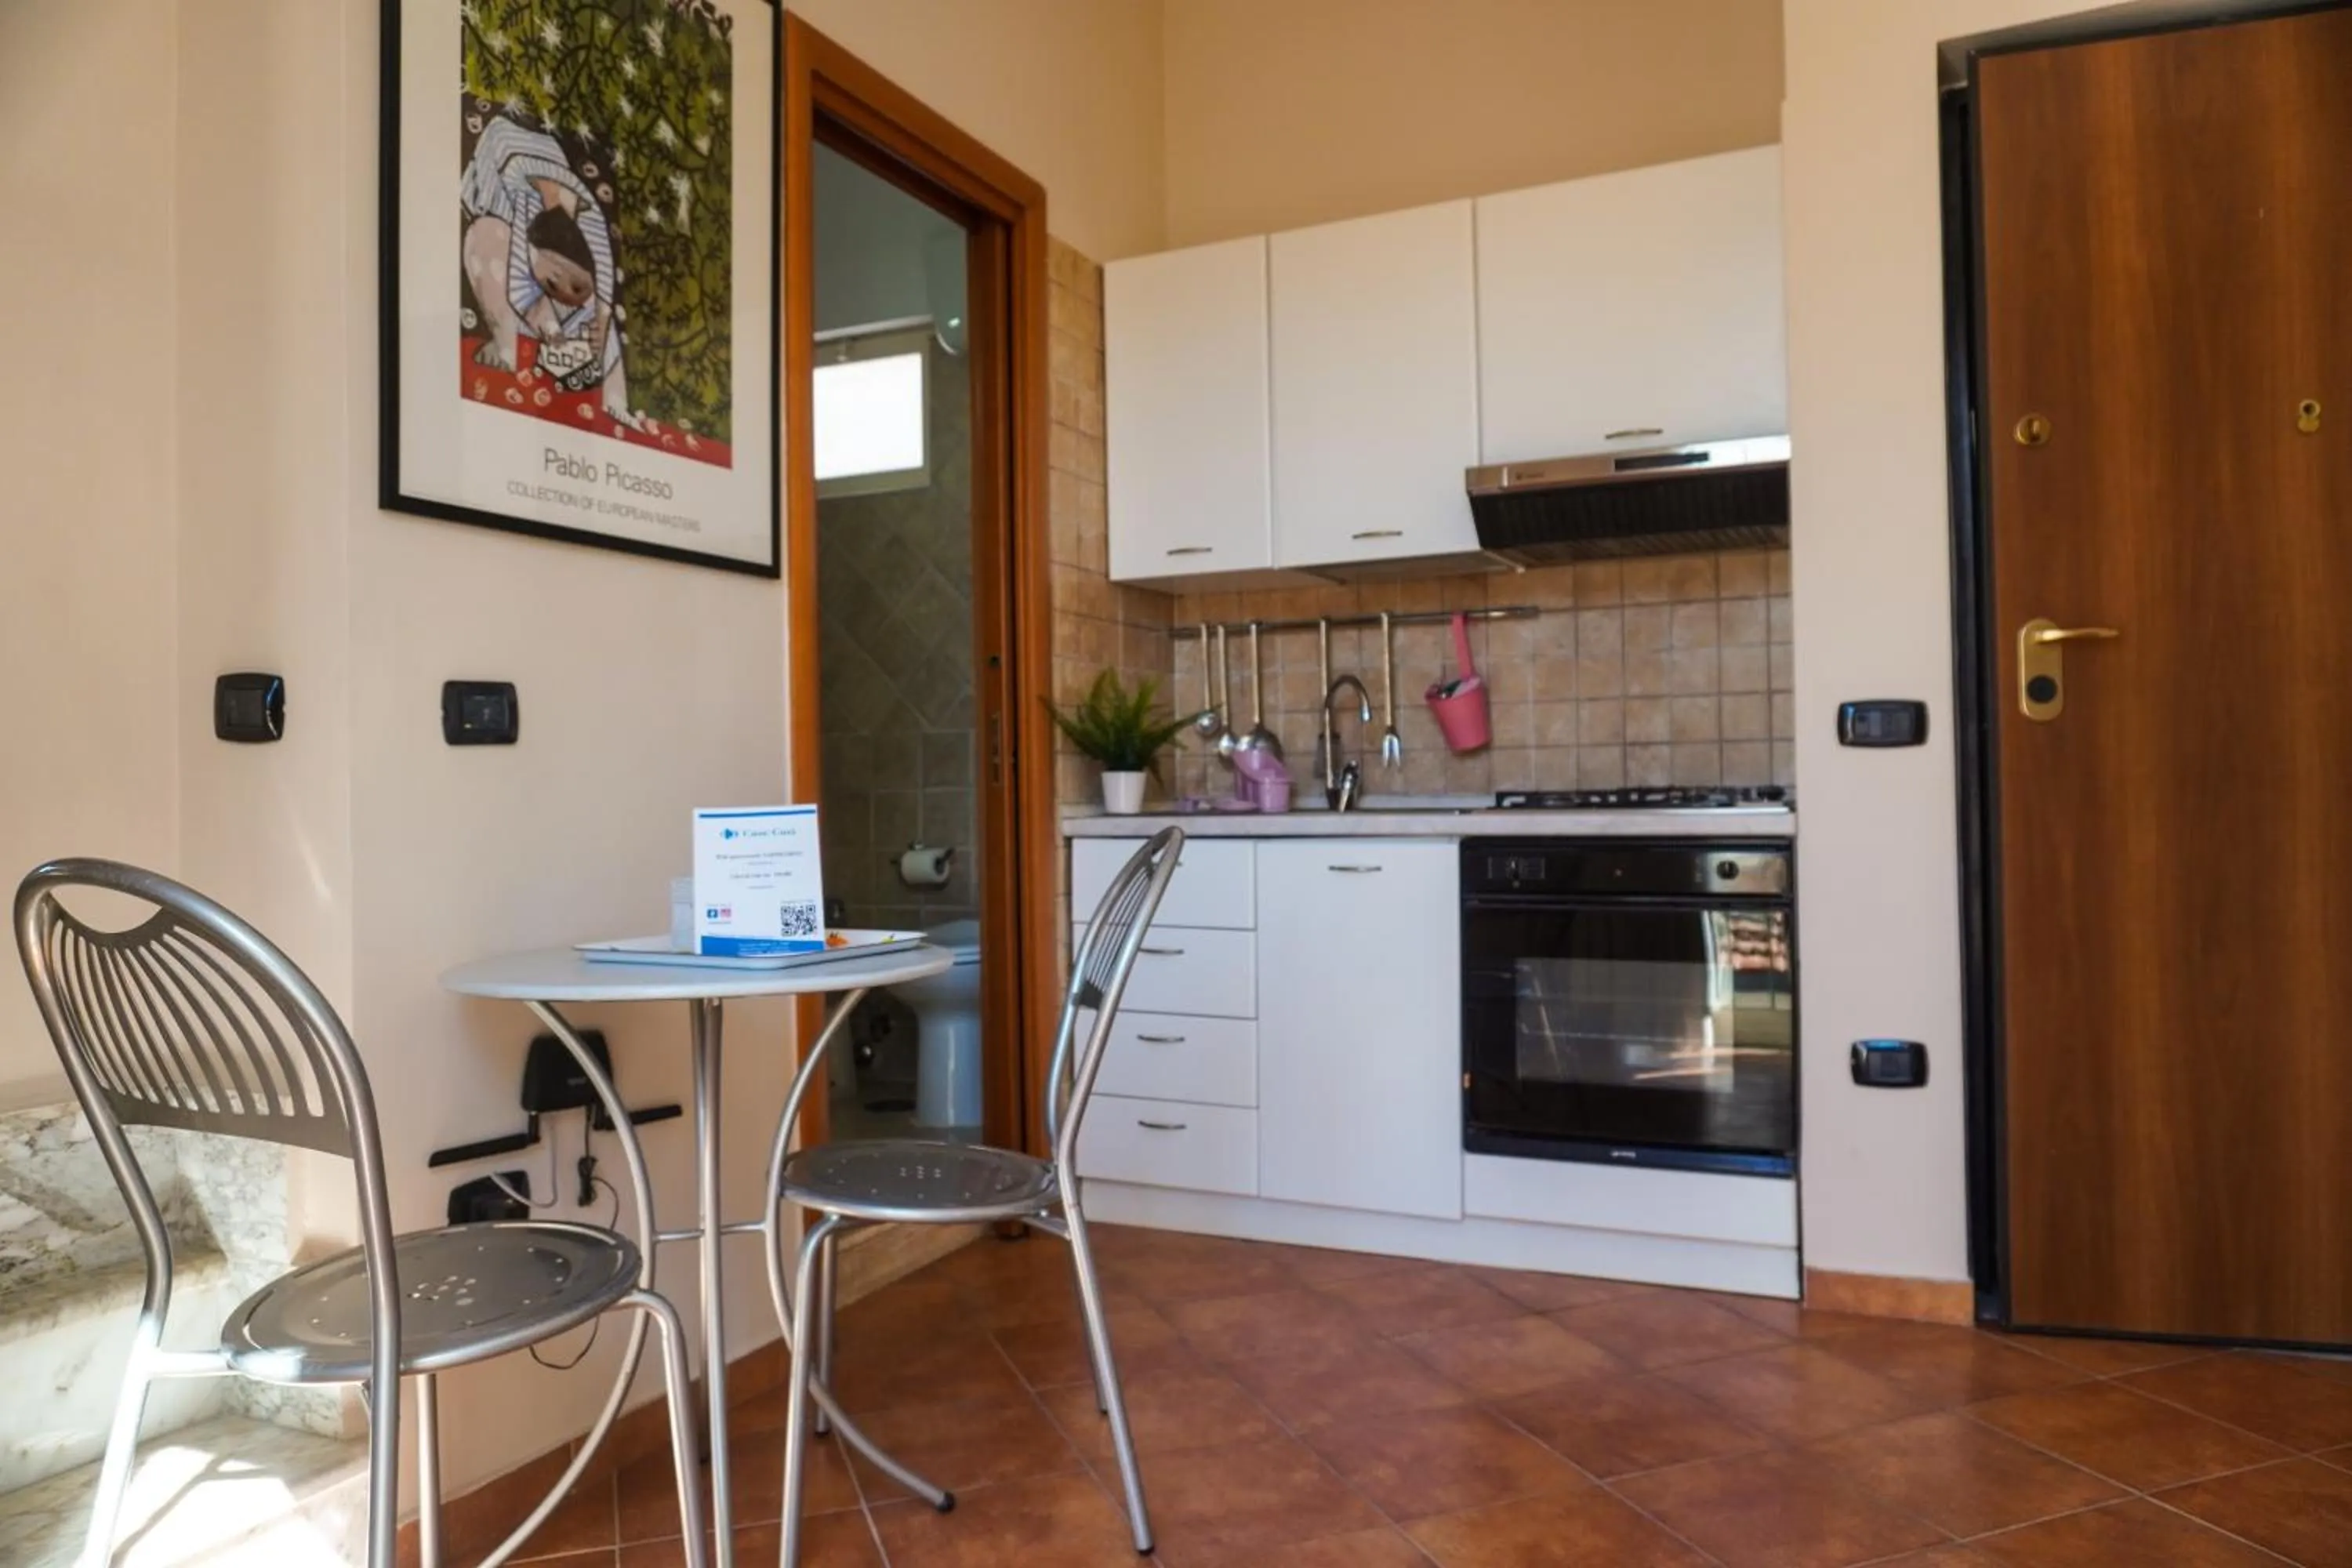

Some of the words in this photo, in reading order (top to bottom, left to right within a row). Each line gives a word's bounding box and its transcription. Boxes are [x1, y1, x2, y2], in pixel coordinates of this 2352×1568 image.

[543, 446, 598, 484] Pablo
[605, 461, 674, 501] Picasso
[506, 479, 579, 509] COLLECTION
[580, 495, 594, 511] OF
[597, 499, 654, 524] EUROPEAN
